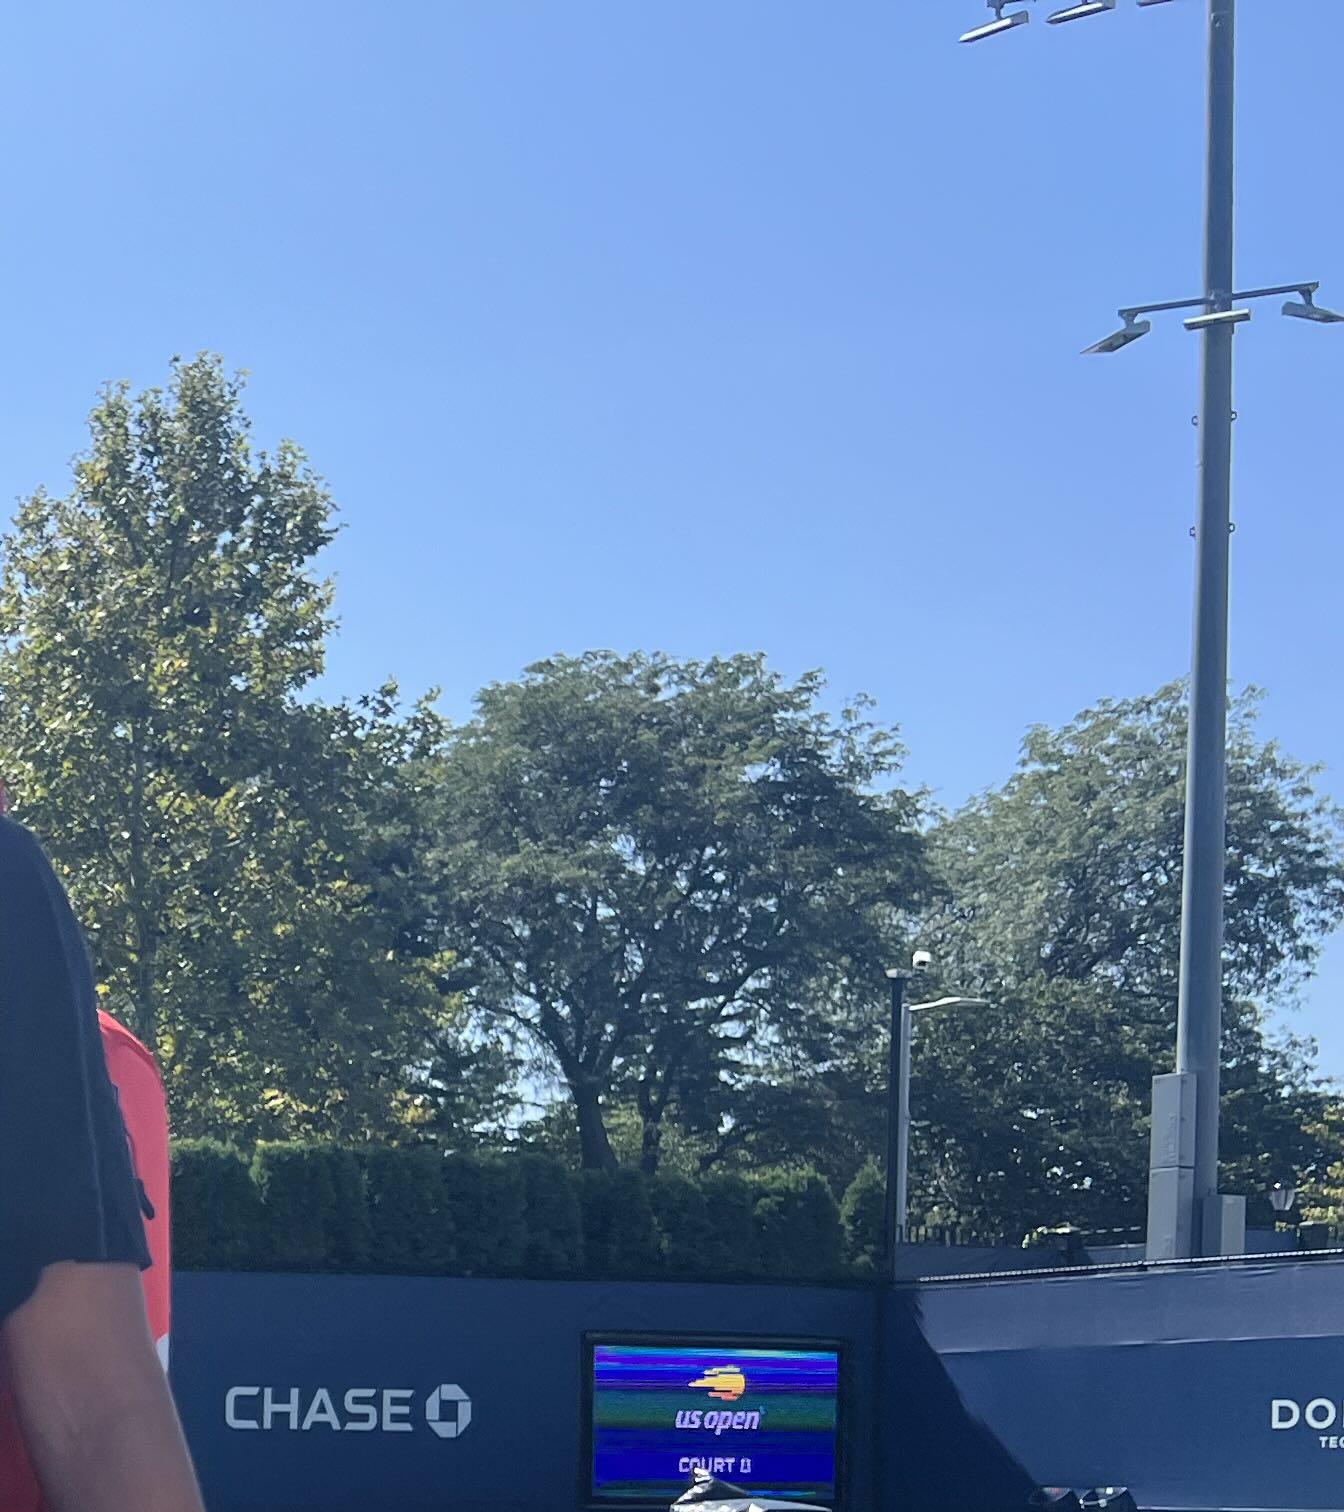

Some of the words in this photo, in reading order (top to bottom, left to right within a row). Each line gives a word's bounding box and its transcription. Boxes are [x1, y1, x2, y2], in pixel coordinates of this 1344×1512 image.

[225, 1386, 414, 1431] CHASE
[675, 1410, 703, 1429] us
[703, 1410, 760, 1435] open
[1272, 1398, 1344, 1430] DO
[678, 1457, 735, 1473] COURT
